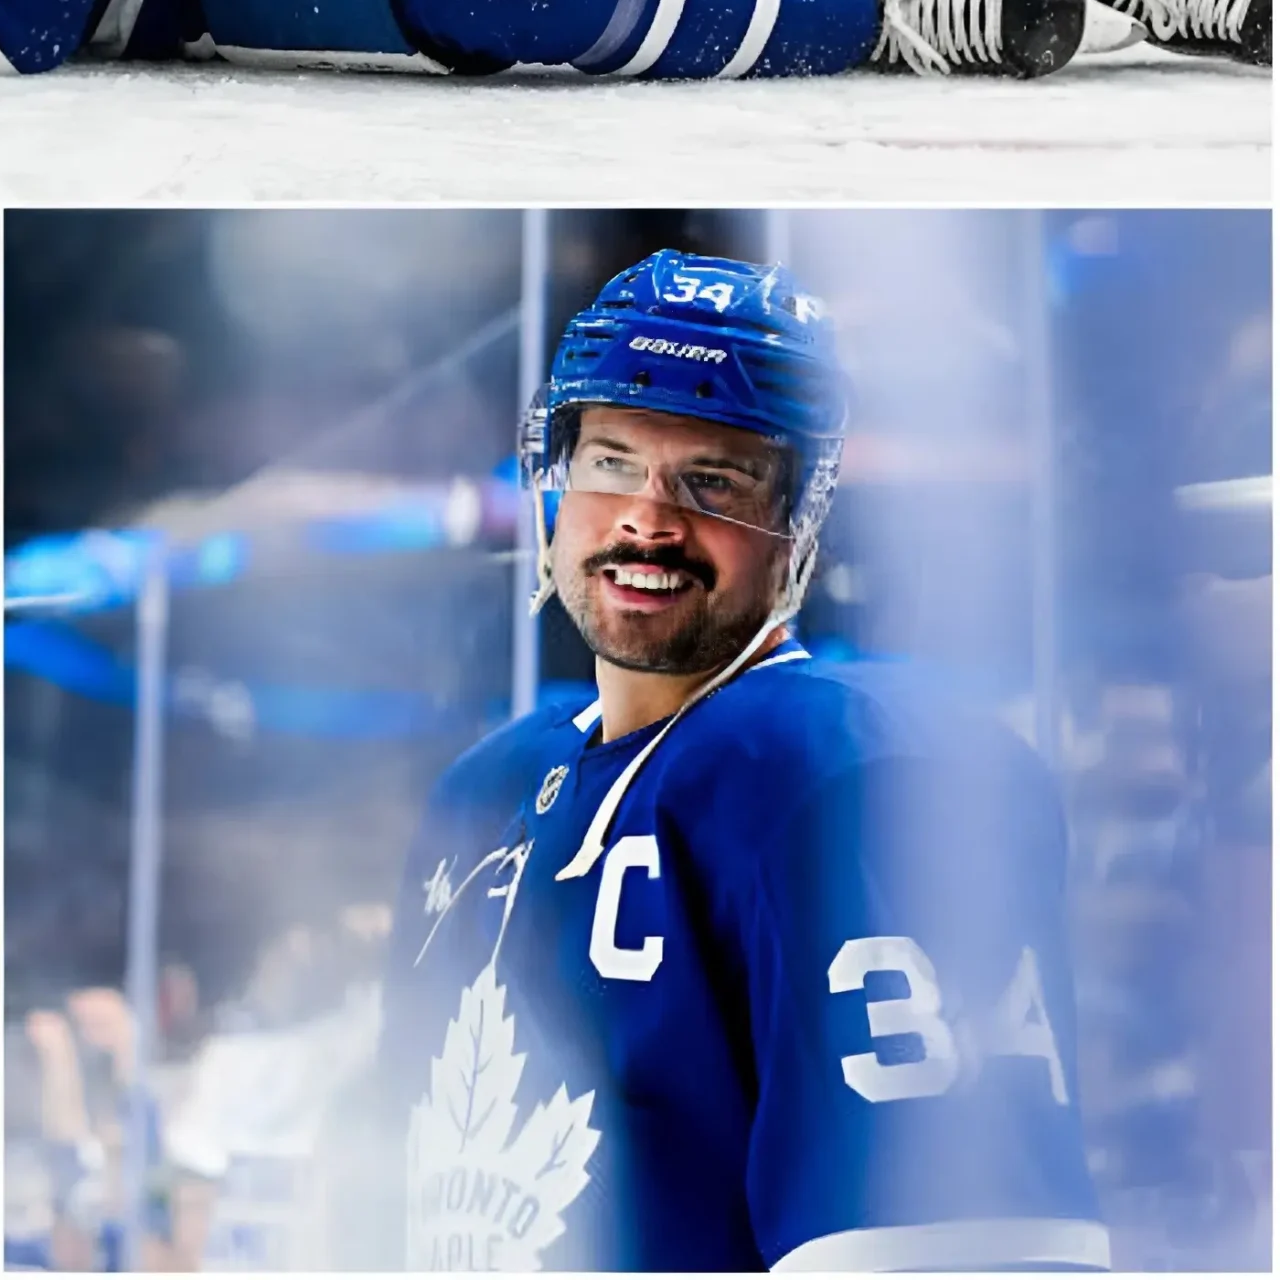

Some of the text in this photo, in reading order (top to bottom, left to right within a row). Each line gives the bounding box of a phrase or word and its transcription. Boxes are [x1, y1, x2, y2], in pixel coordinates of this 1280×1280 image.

[663, 274, 734, 313] 34
[588, 834, 664, 982] C
[827, 935, 1070, 1107] 34
